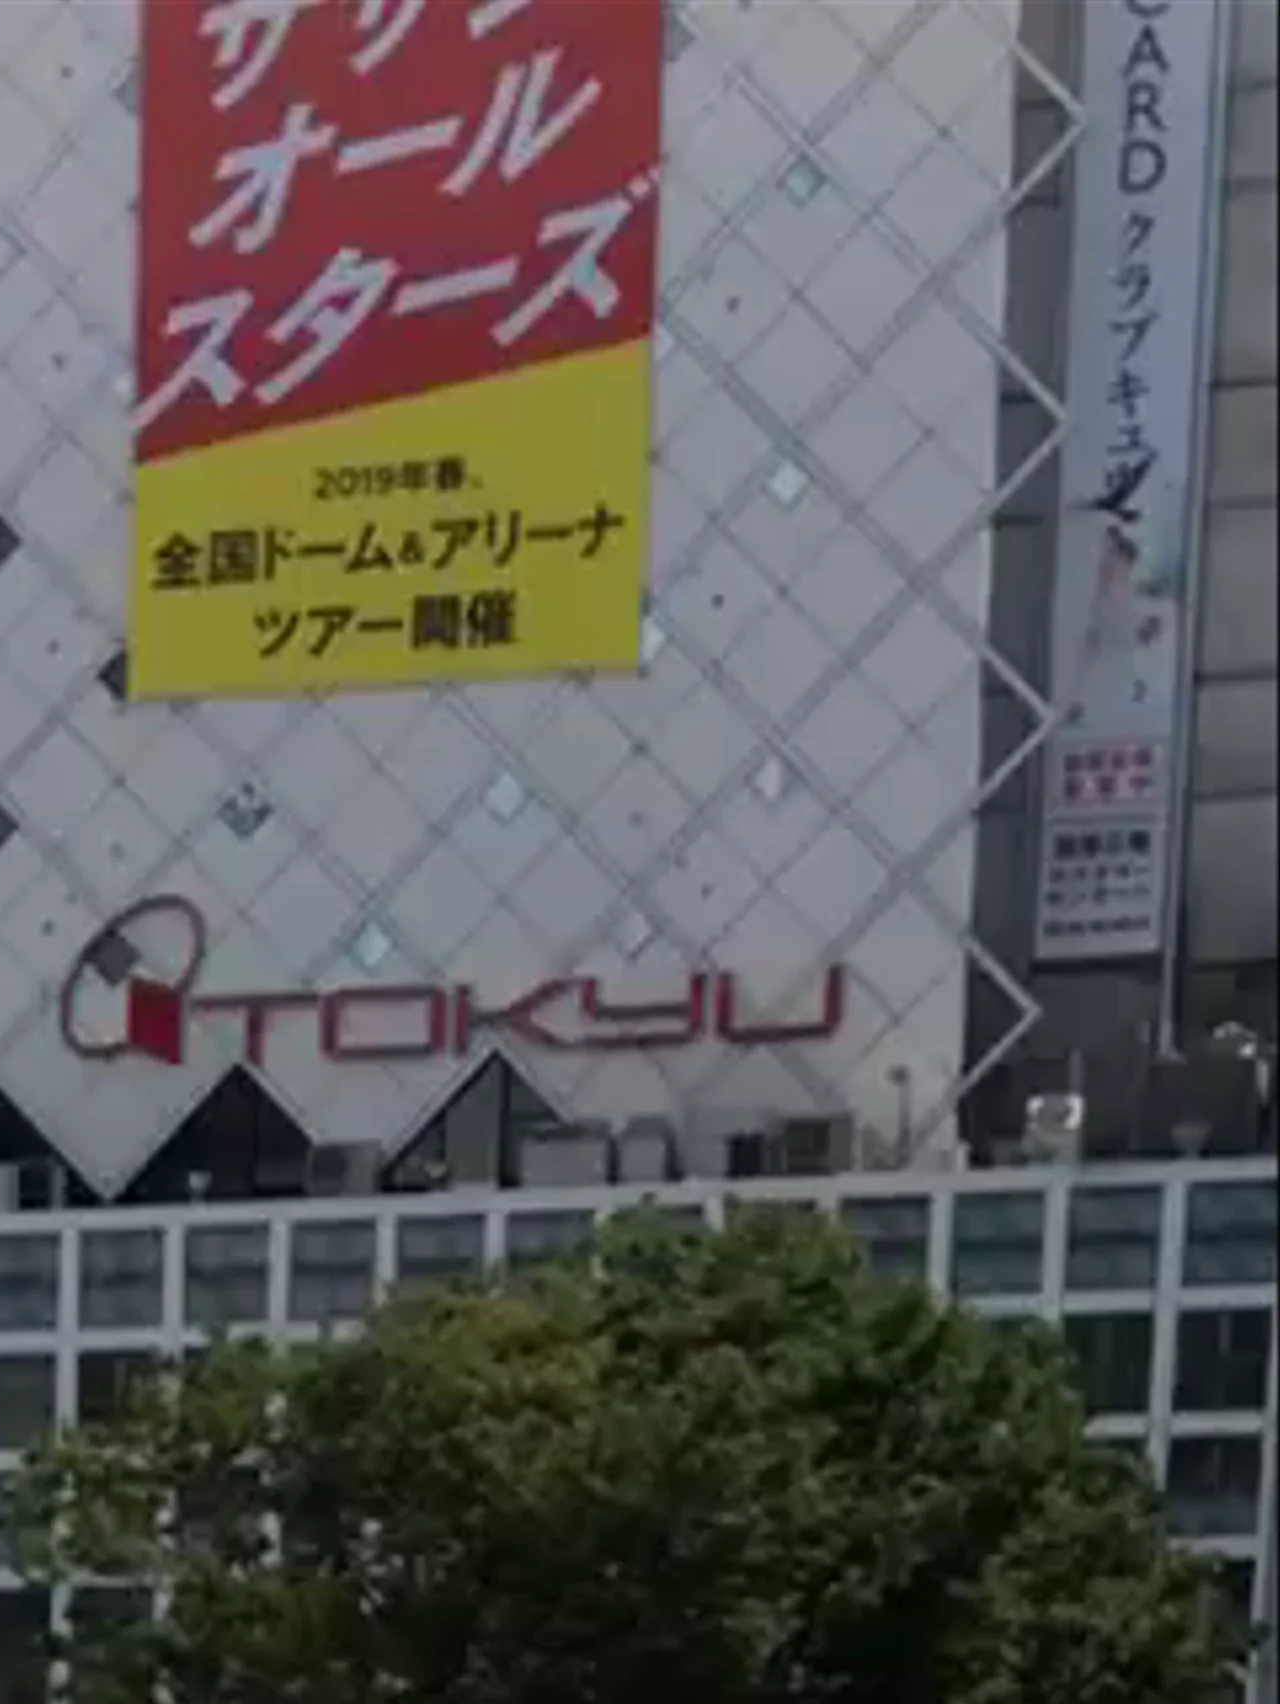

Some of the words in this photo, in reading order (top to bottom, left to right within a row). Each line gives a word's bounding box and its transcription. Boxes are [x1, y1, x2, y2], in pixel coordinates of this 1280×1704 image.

[186, 46, 603, 254] オール
[126, 166, 660, 440] スターズ
[149, 502, 627, 592] 全国ドーム&アリーナ
[252, 590, 520, 660] ツアー開催
[192, 962, 849, 1066] TOKYU
